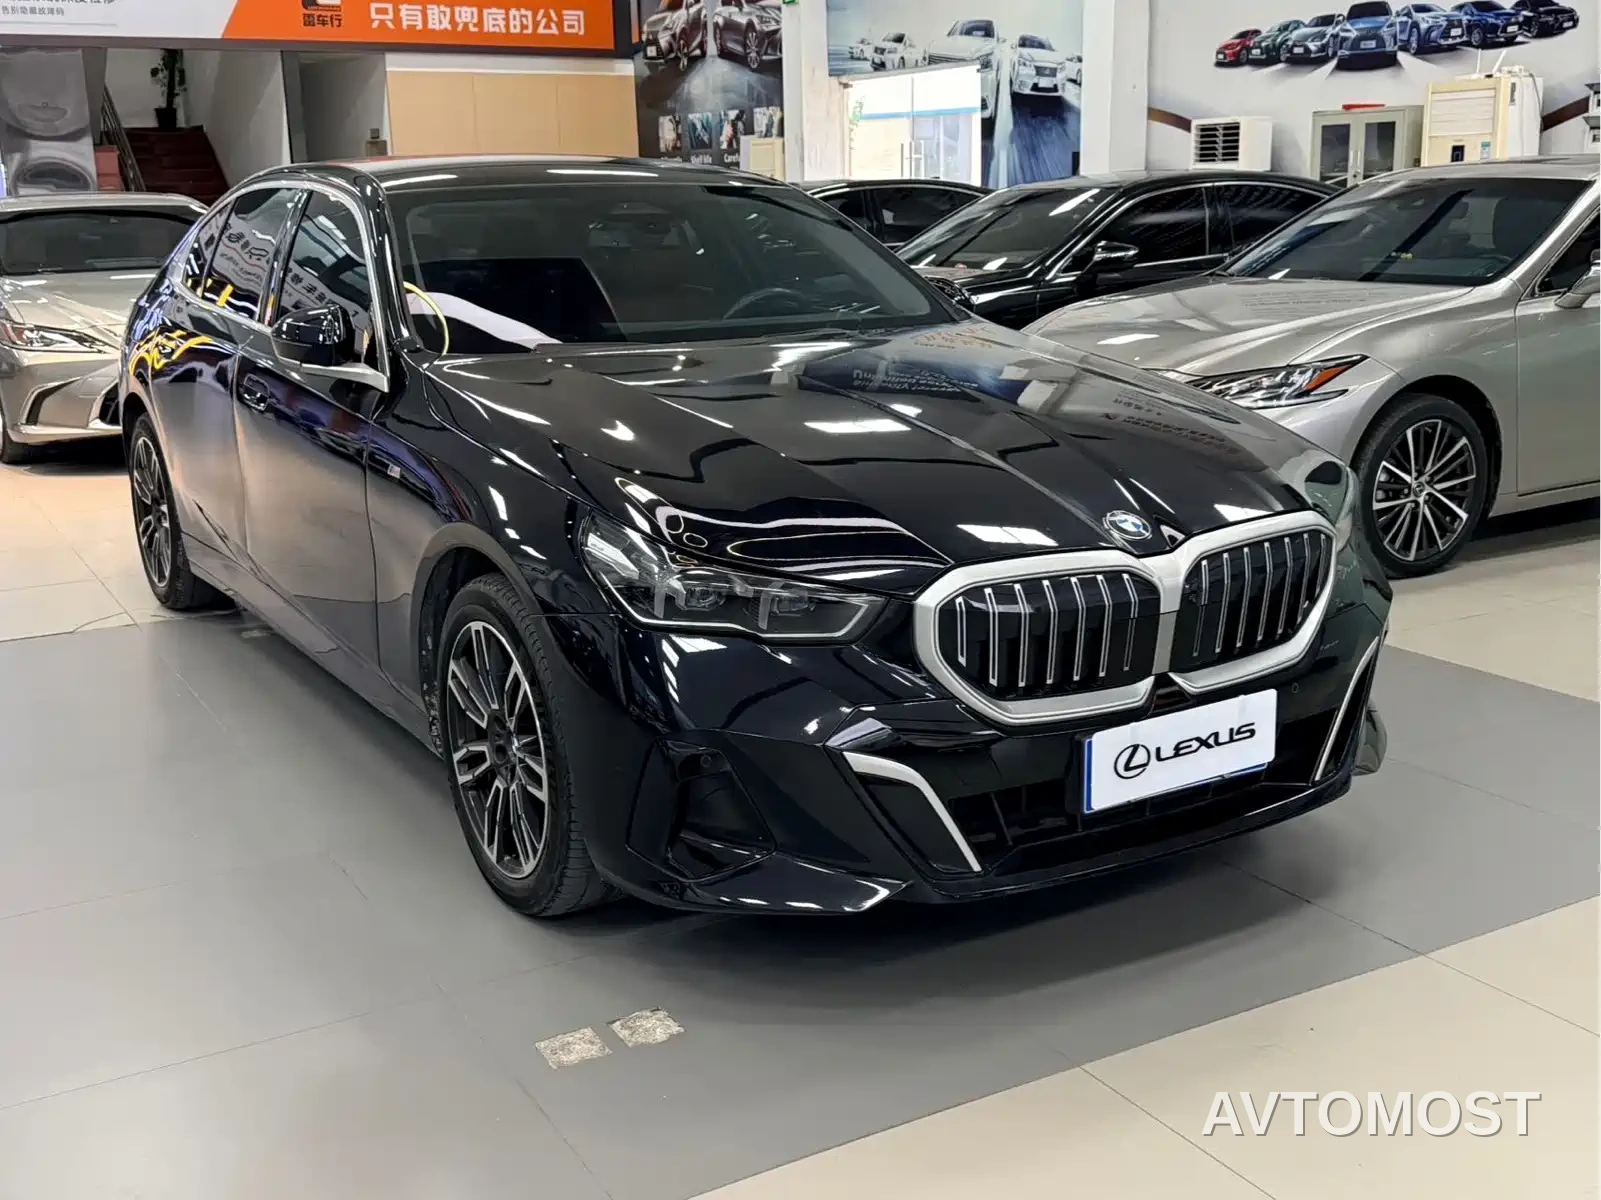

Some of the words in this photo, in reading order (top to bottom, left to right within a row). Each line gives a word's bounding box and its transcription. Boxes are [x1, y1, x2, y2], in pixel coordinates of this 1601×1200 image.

[2, 5, 65, 16] 告别隐藏故障码
[369, 2, 585, 35] 只有敢兜底的公司
[1155, 722, 1256, 762] LEXUS
